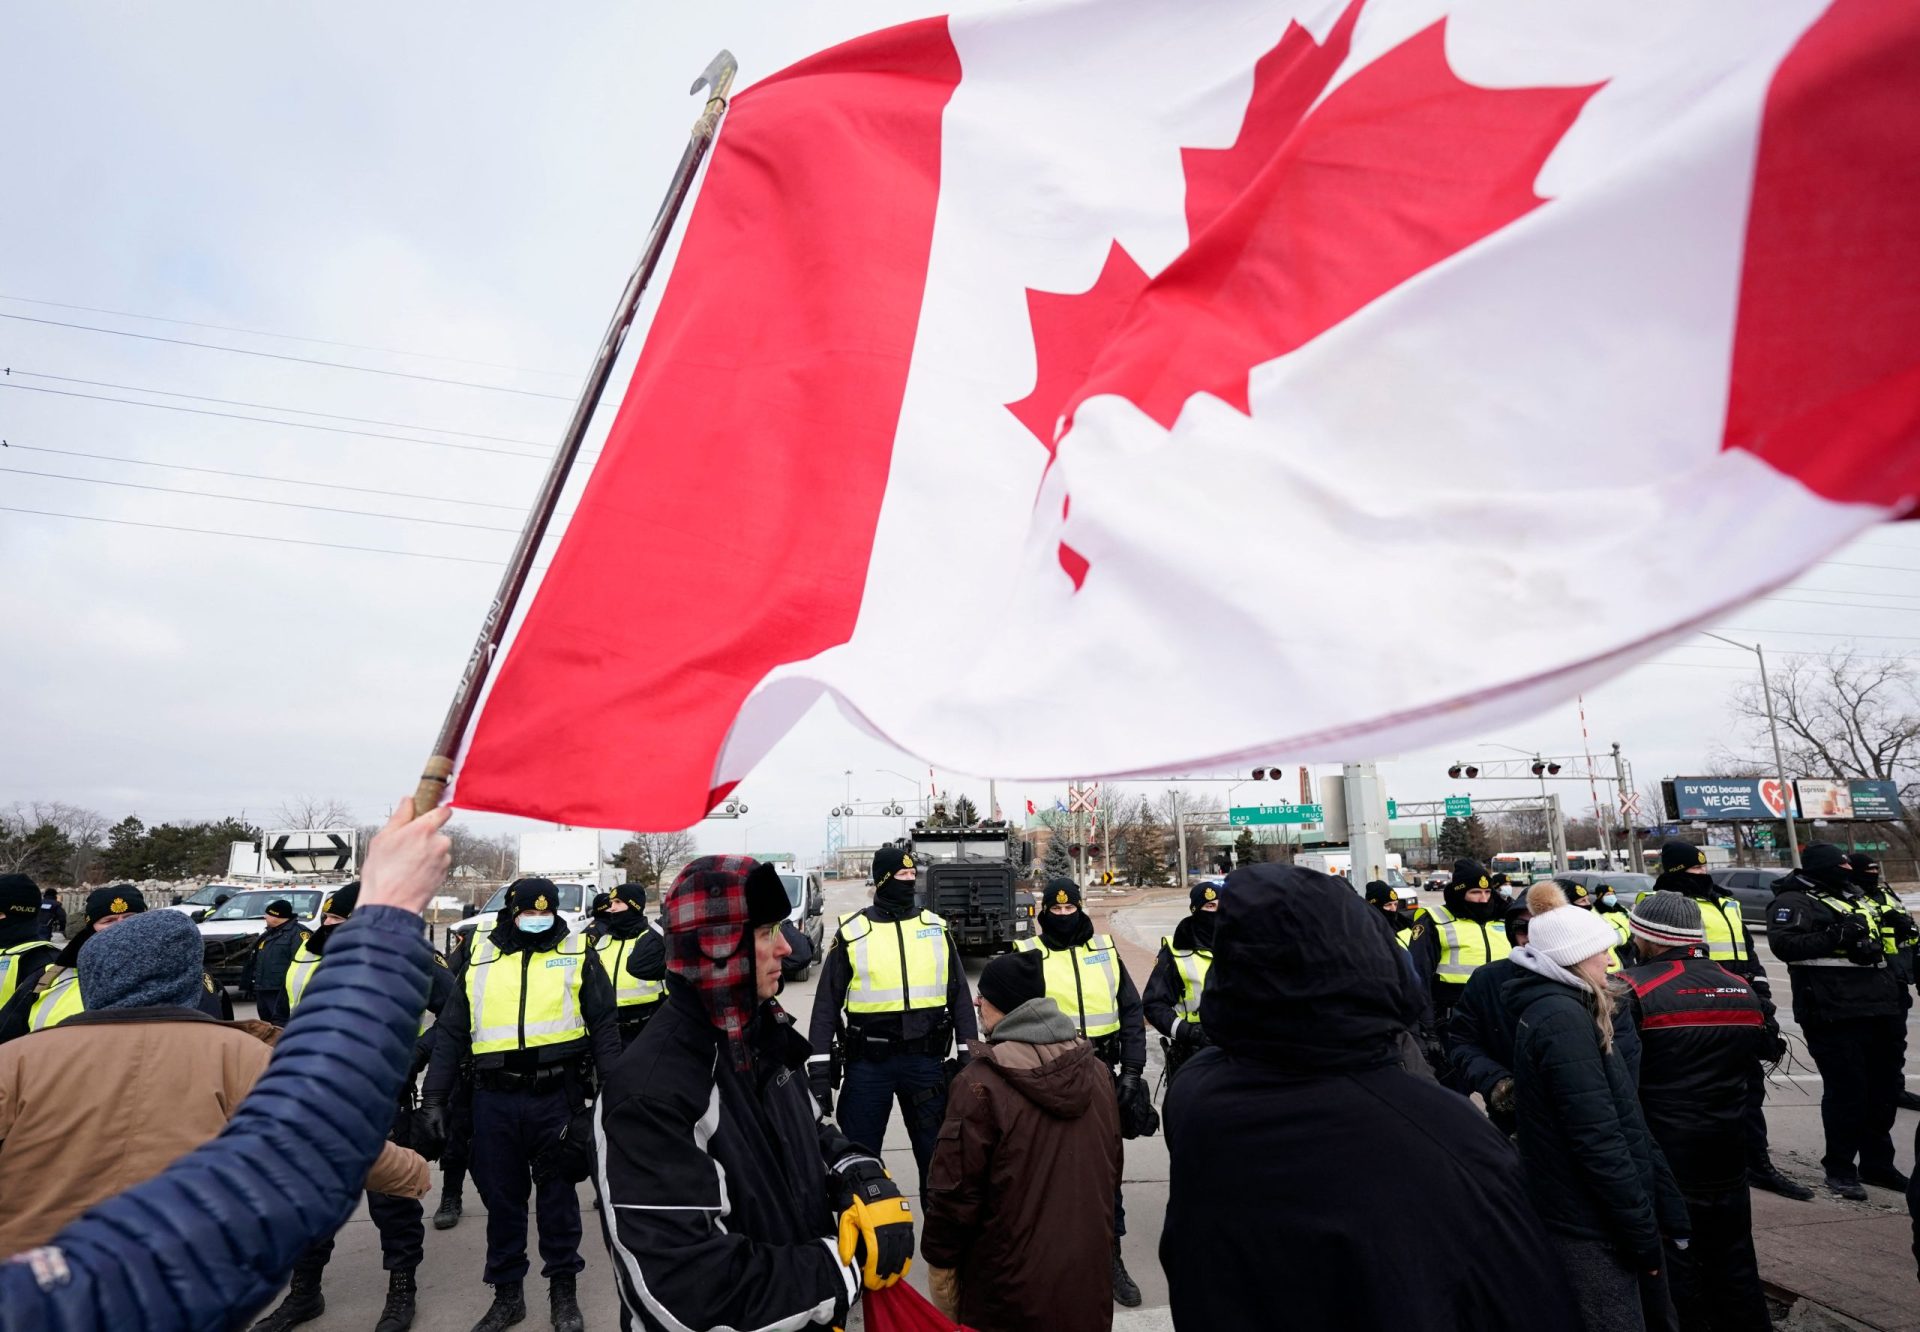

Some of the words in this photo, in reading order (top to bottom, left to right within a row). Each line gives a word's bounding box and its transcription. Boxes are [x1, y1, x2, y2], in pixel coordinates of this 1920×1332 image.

[1684, 785, 1698, 794] FLY
[1719, 785, 1751, 794] because
[1703, 795, 1720, 806] WE
[1721, 795, 1750, 806] CARE
[1259, 806, 1299, 815] BRIDGE
[10, 904, 37, 914] POLICE
[917, 928, 942, 938] POLICE
[546, 957, 577, 968] POLICE
[1084, 952, 1110, 964] POLICE
